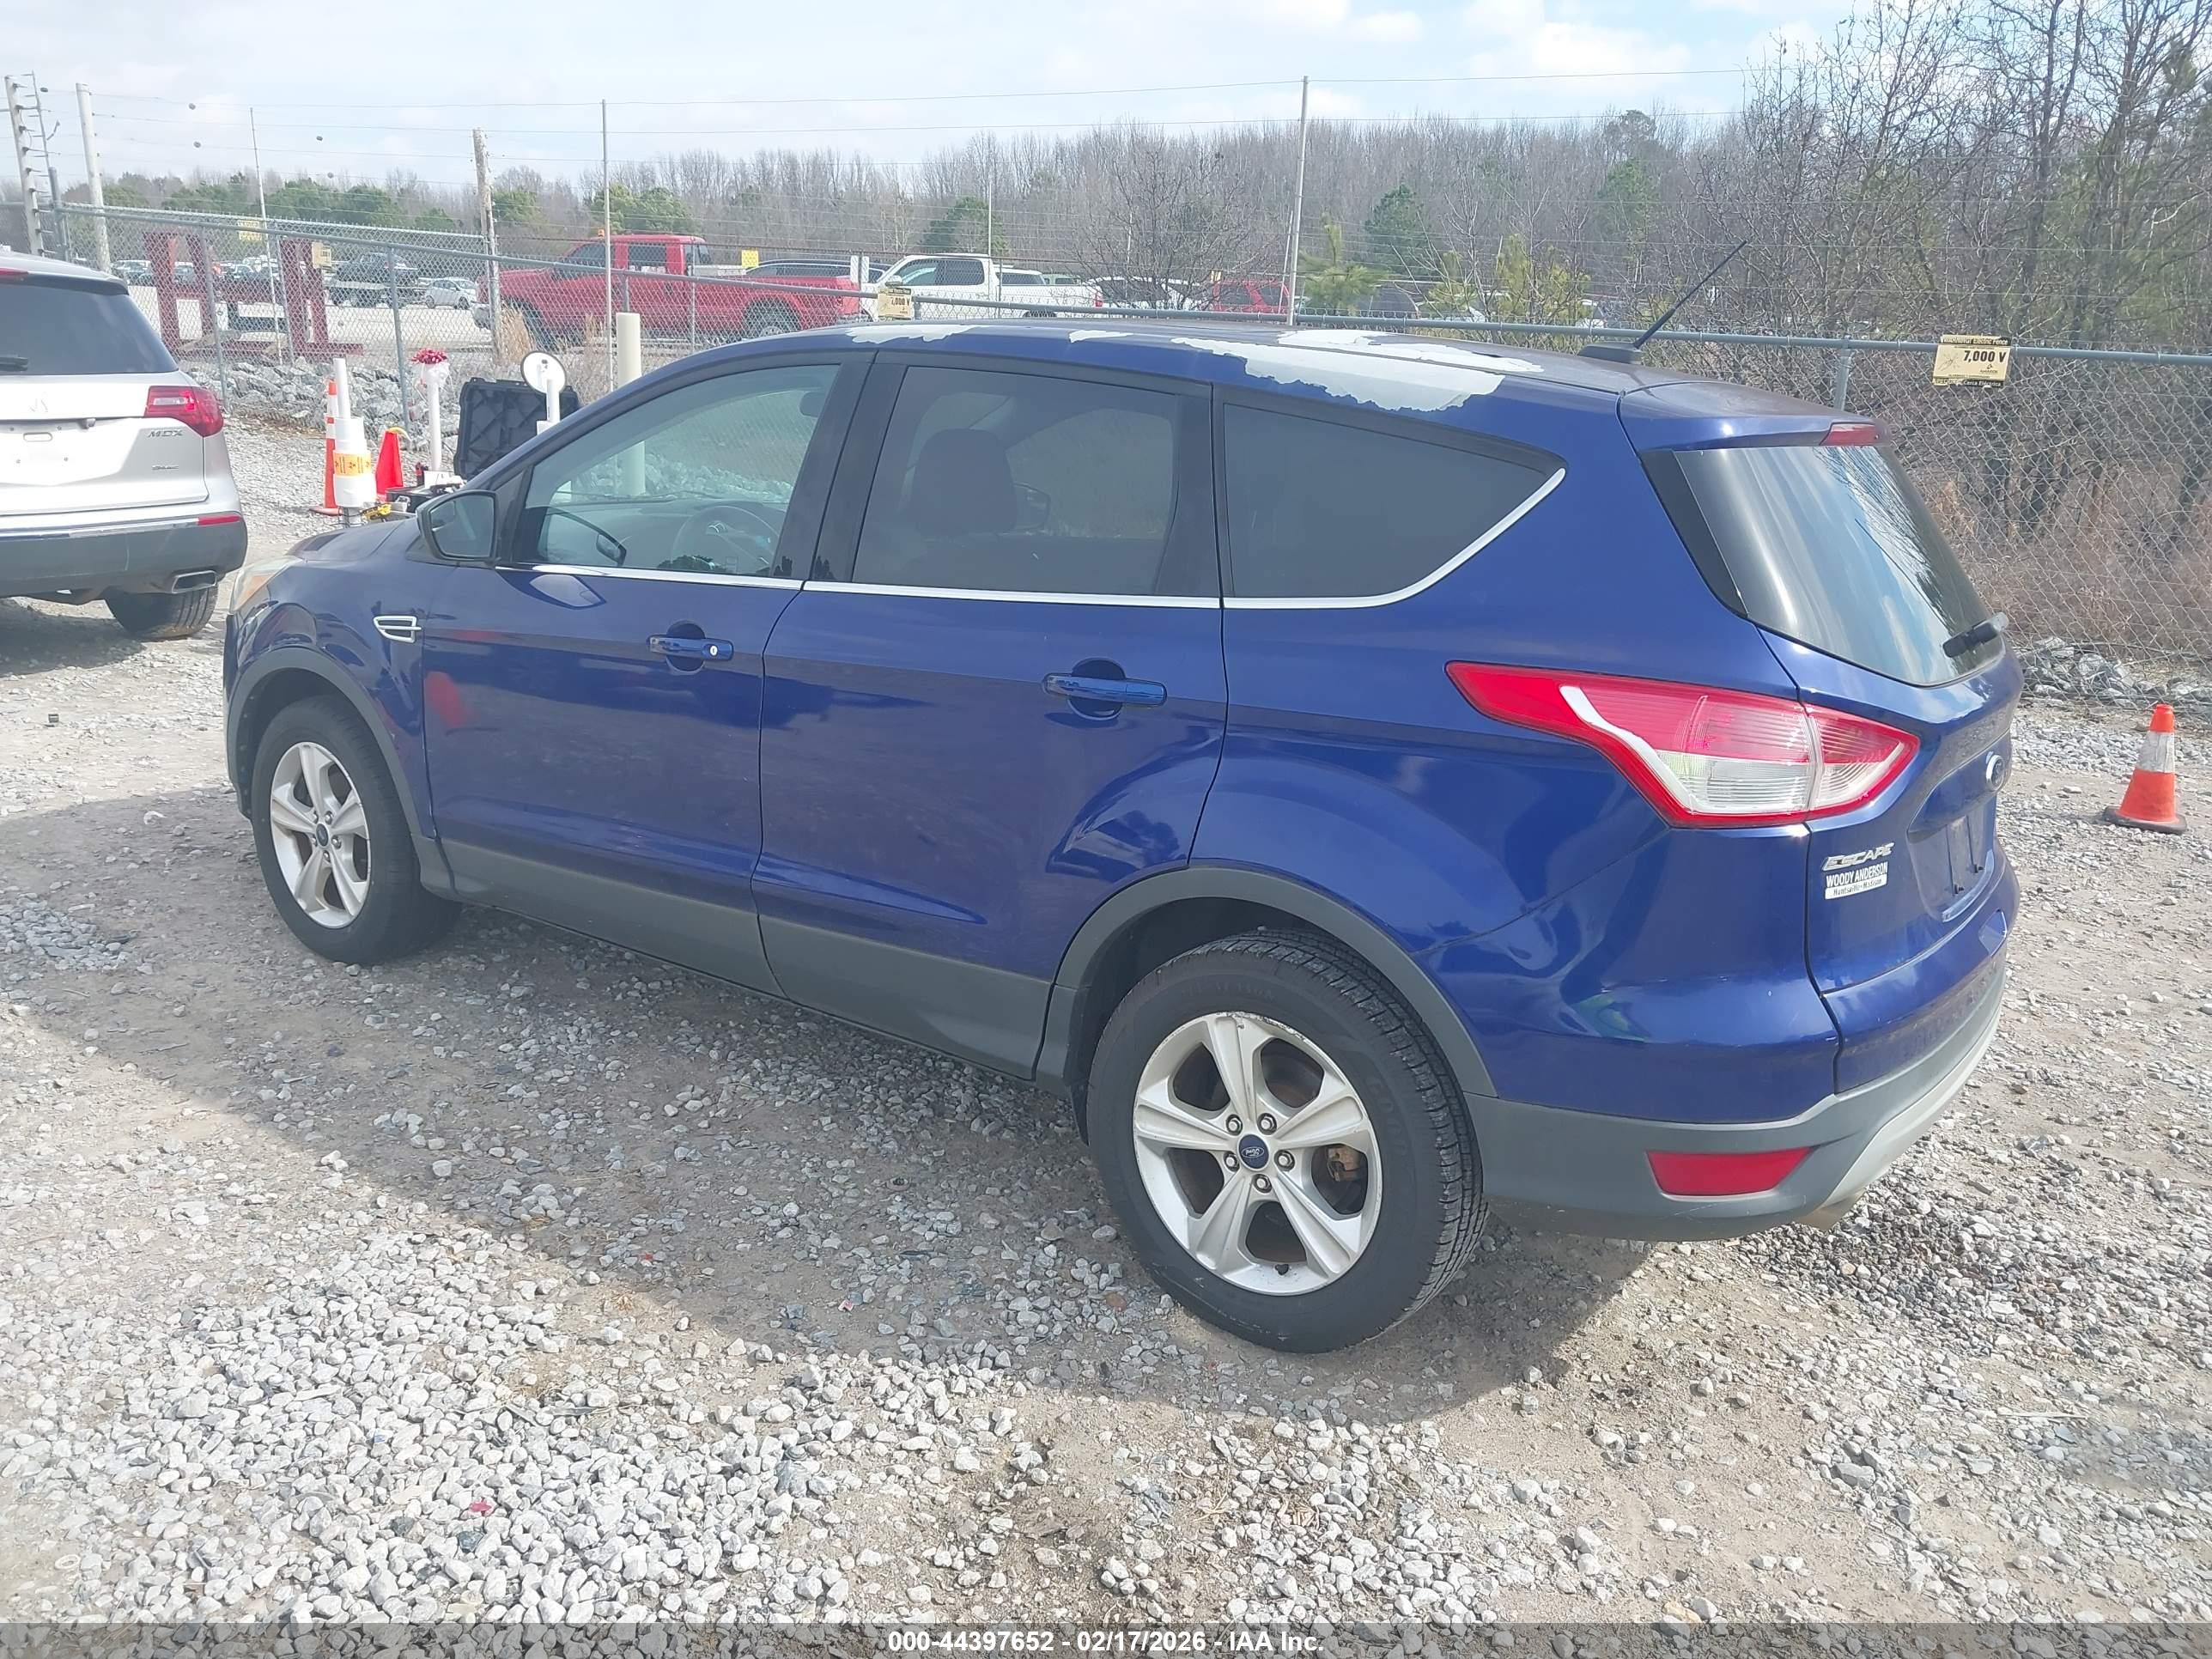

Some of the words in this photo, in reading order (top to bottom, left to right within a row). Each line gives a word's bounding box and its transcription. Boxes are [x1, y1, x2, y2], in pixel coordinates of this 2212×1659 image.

[906, 297, 910, 307] V
[1963, 349, 1996, 362] 7,000
[1999, 351, 2007, 362] V
[148, 429, 183, 438] MDX
[1823, 842, 1895, 872] ESCAPE
[1826, 871, 1855, 888] WOODY
[1855, 861, 1888, 883] ANDERSON
